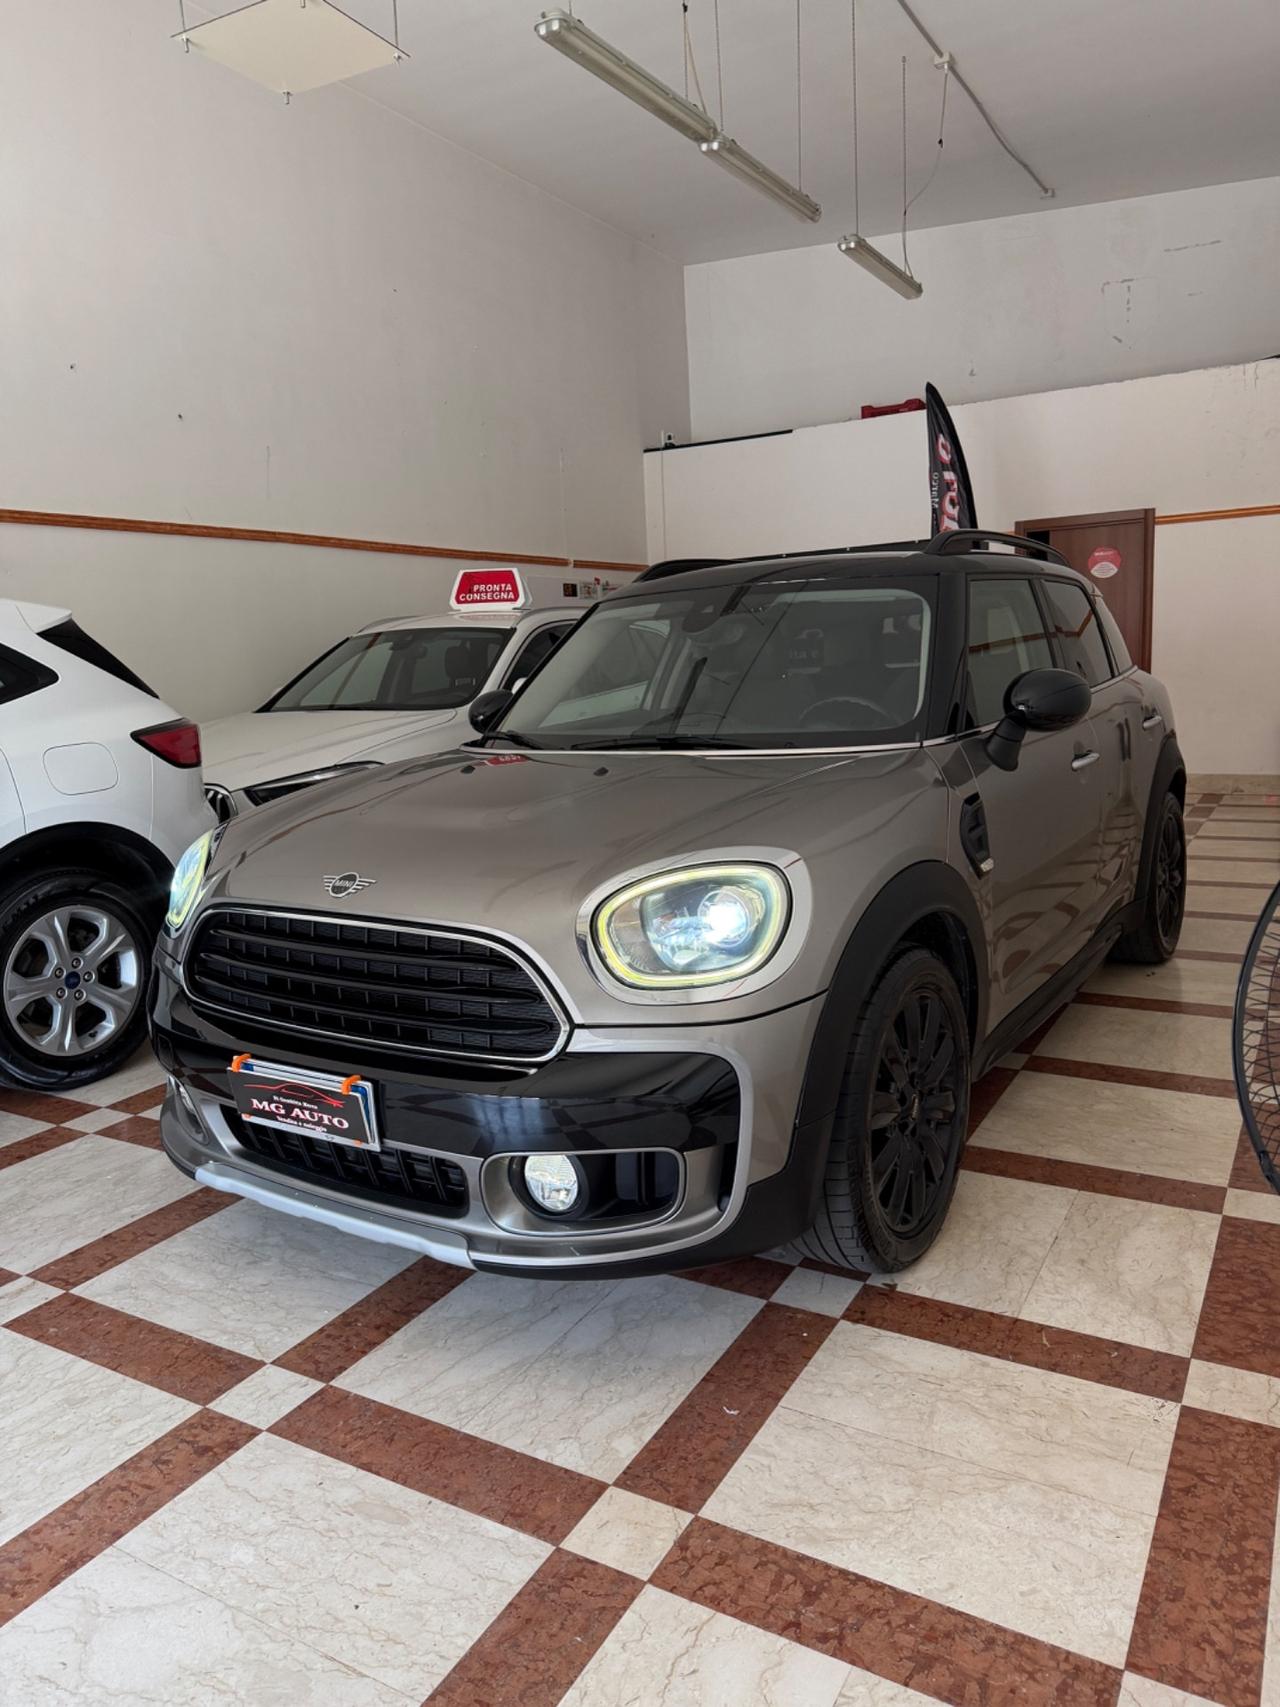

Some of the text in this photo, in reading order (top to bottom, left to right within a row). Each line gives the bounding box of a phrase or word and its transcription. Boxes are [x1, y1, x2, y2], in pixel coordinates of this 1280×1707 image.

[473, 583, 512, 592] PRONTA
[459, 592, 515, 601] CONSEGNA
[335, 879, 355, 888] MINI
[251, 1098, 286, 1115] MG
[291, 1107, 349, 1129] AUTO
